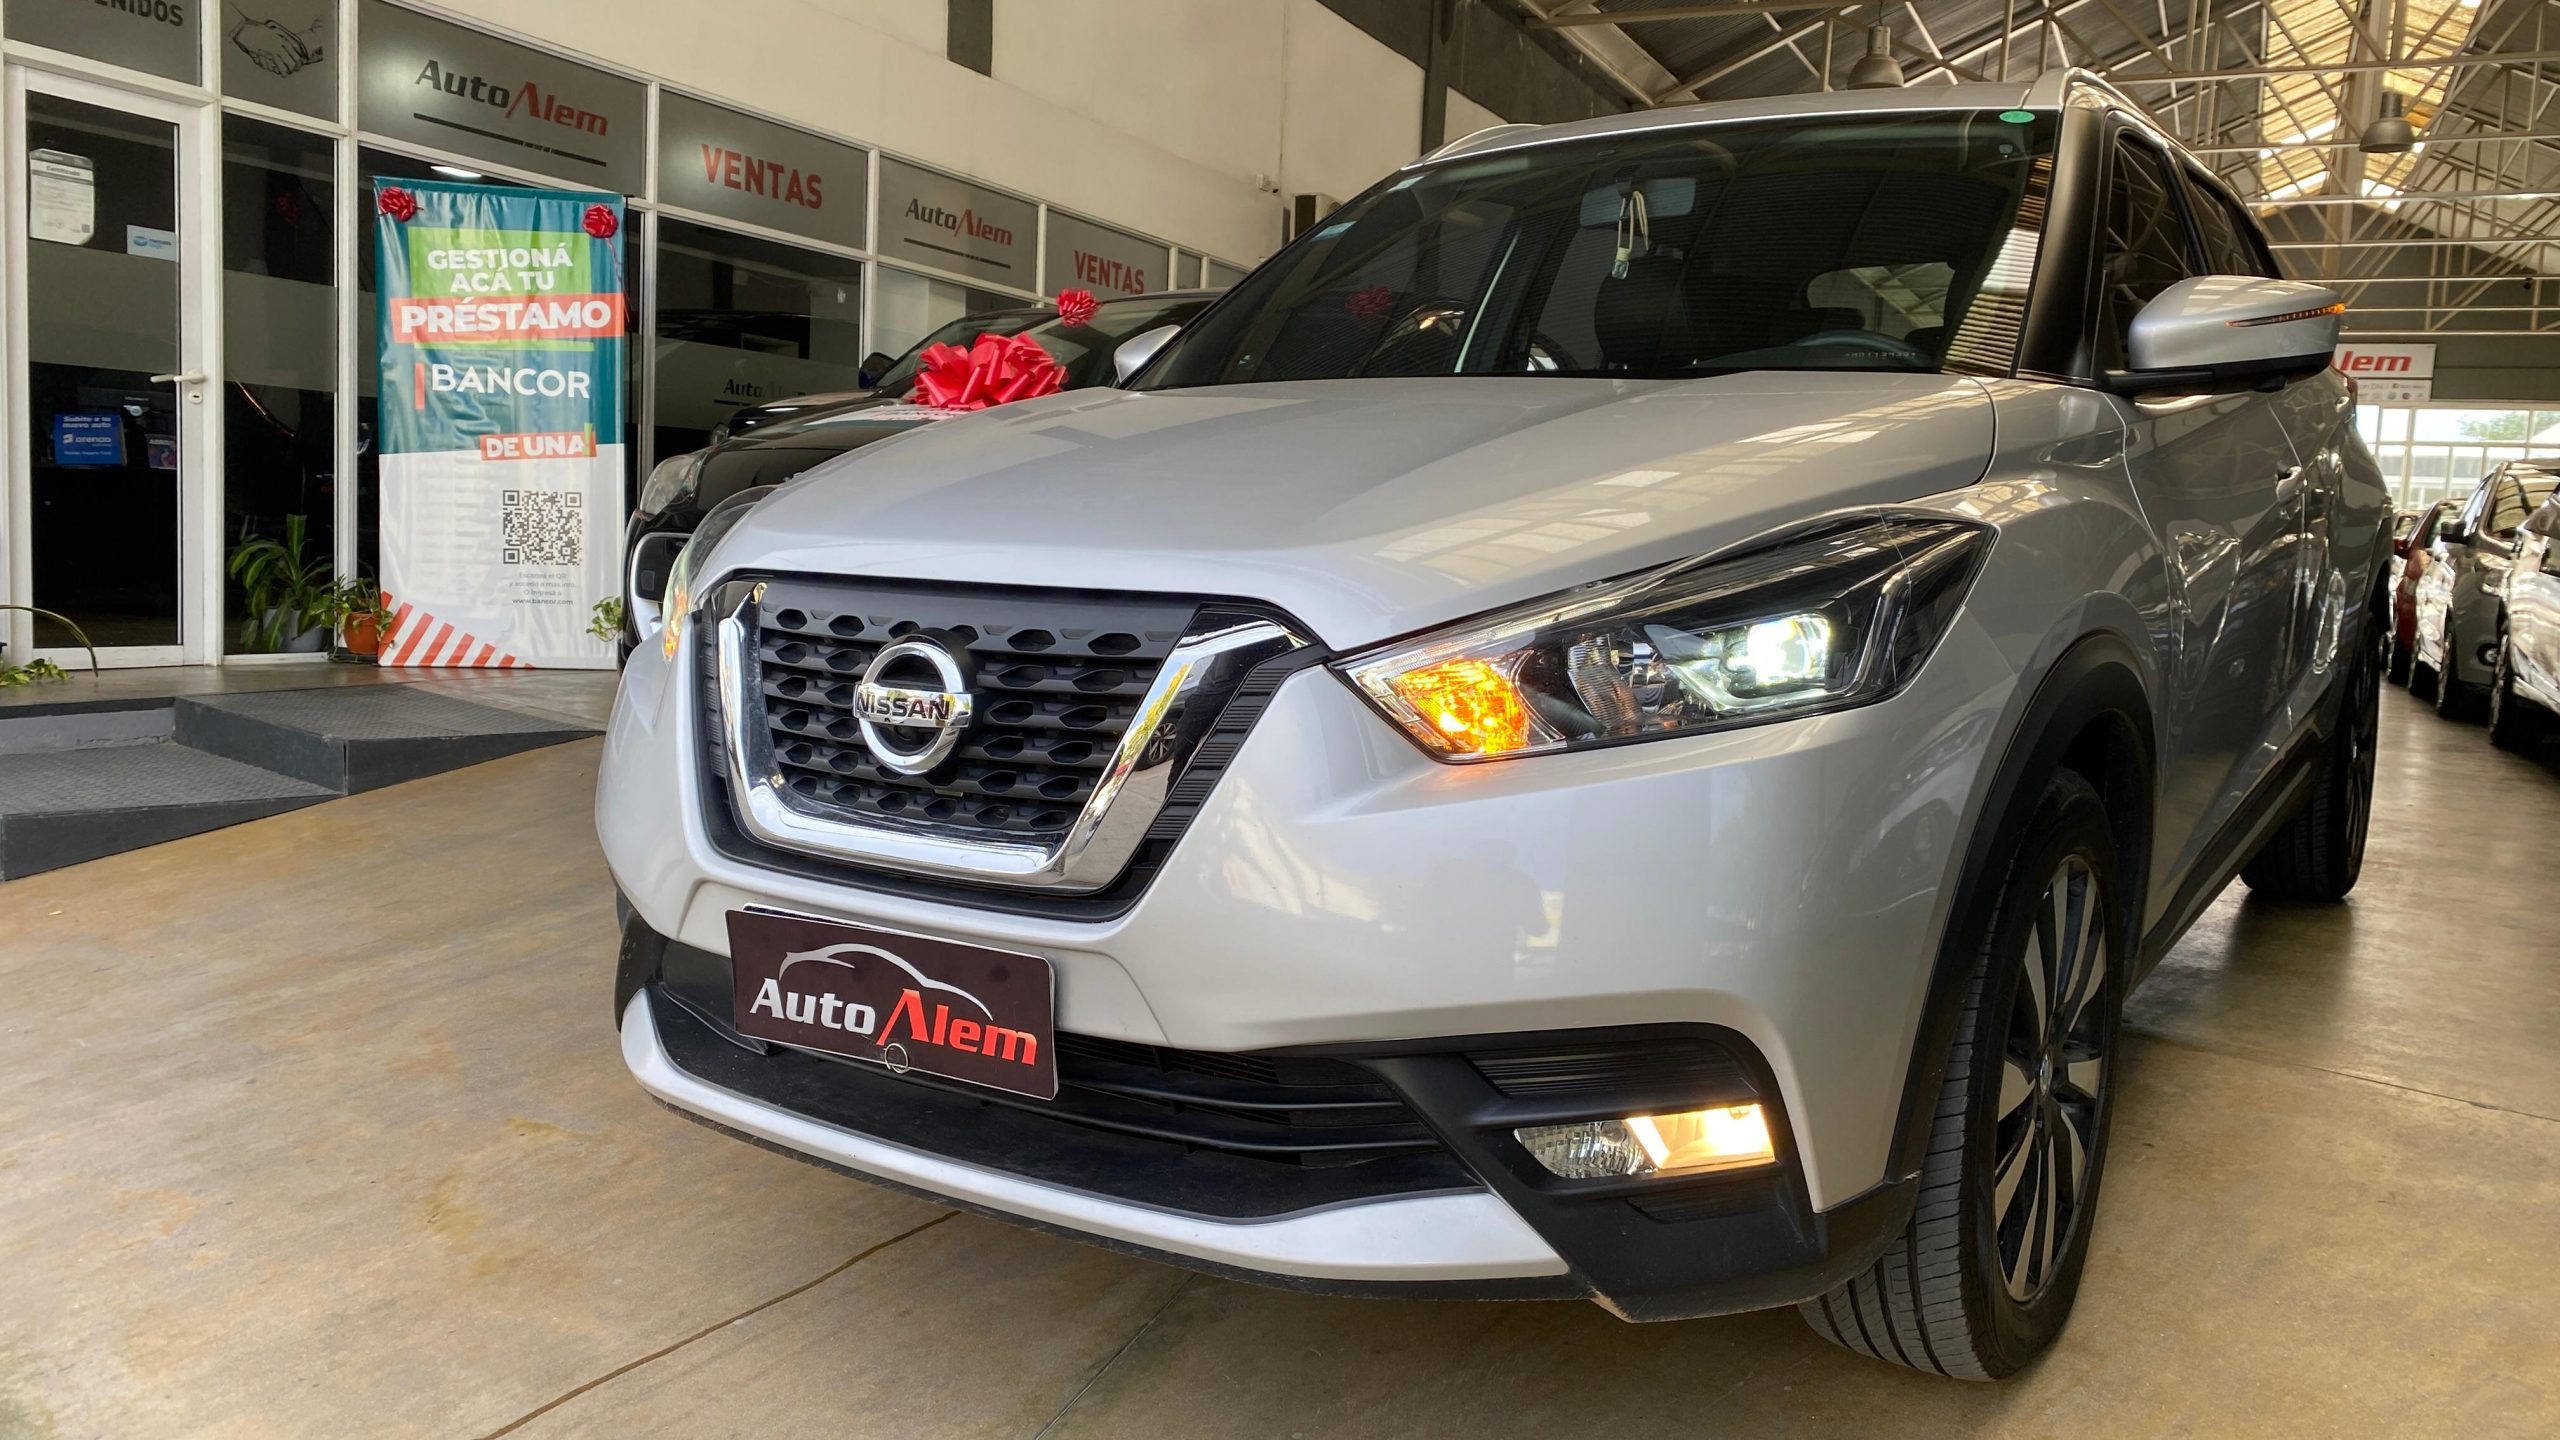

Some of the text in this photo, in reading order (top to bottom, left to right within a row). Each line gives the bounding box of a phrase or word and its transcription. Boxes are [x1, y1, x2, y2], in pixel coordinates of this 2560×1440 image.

[95, 0, 183, 26] IDOS
[701, 143, 822, 209] VENTAS
[427, 242, 574, 270] GESTIONÁ
[450, 267, 555, 293] ACÁ TU
[1074, 250, 1145, 295] VENTAS
[400, 297, 612, 334] PRÉSTAMO
[2333, 351, 2412, 371] lem
[431, 363, 590, 399] BANCOR
[486, 438, 520, 458] DE
[857, 692, 950, 720] NISSAN
